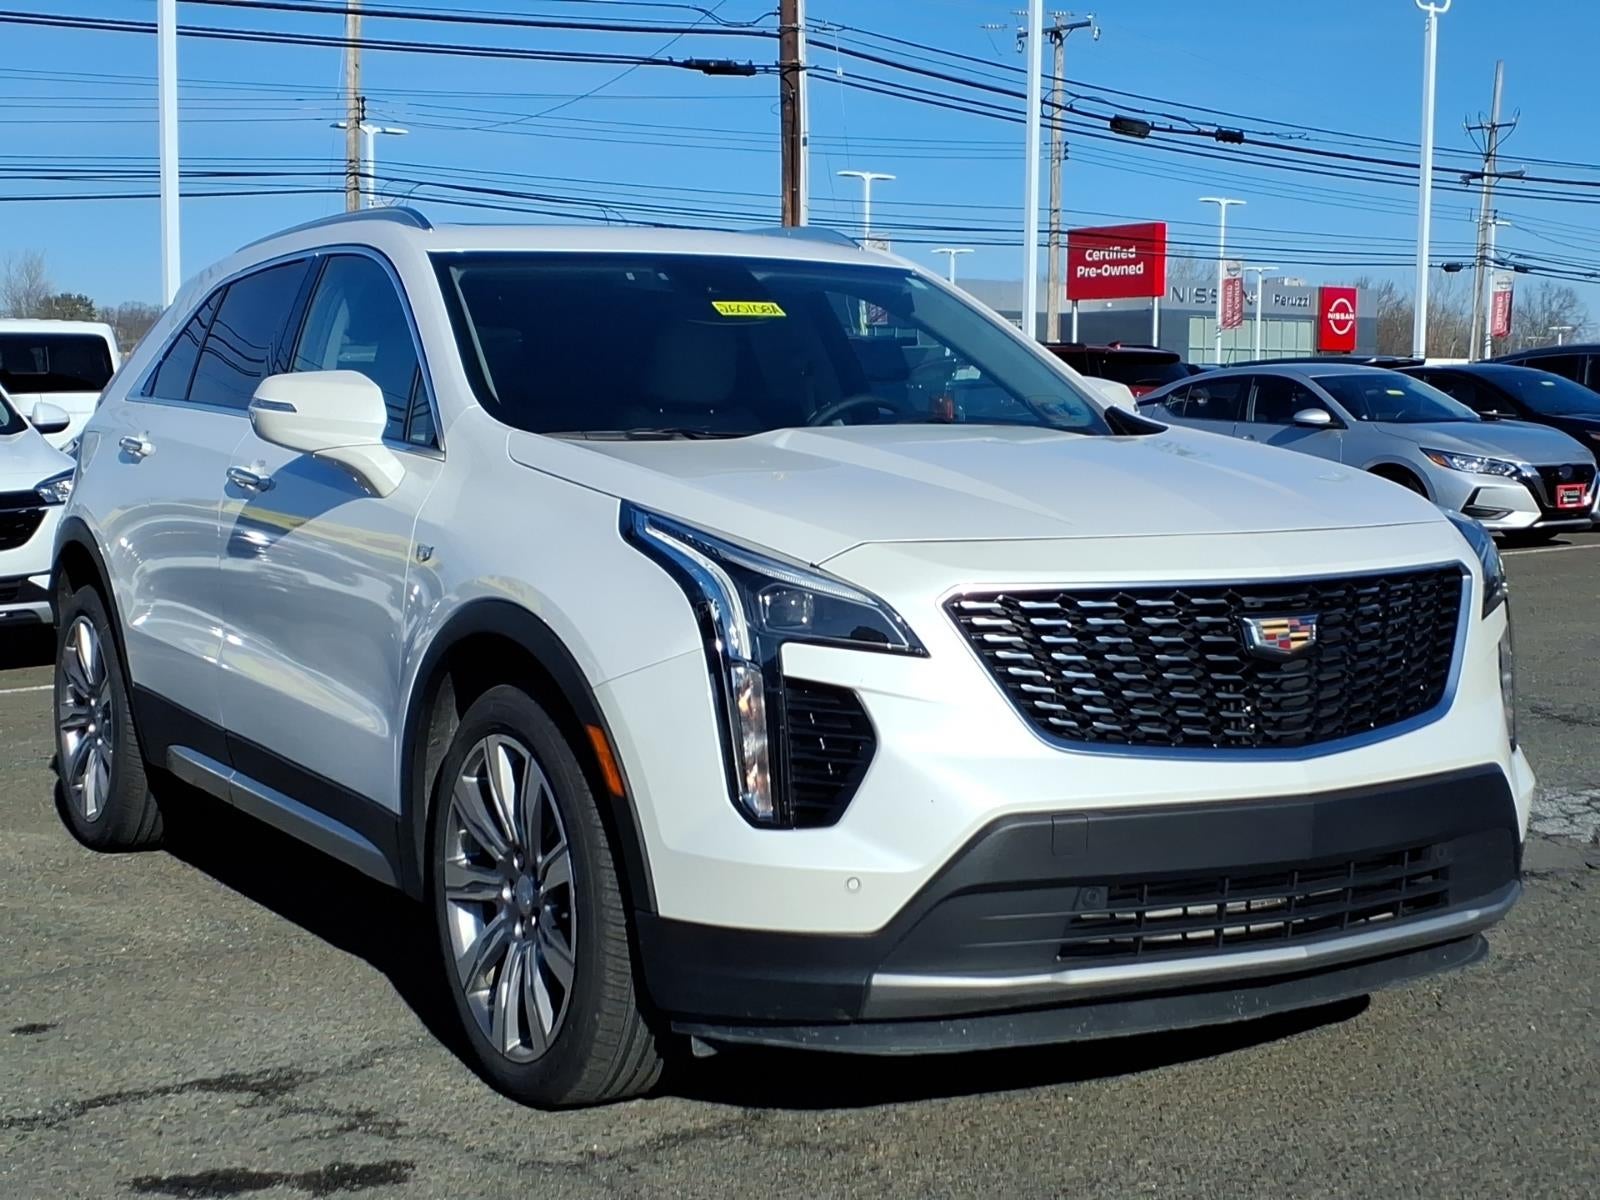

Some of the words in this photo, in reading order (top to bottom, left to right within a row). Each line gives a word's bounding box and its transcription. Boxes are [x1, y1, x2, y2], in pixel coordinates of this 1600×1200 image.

[1085, 245, 1136, 261] Certified
[1077, 261, 1144, 278] Pre-Owned
[1170, 286, 1253, 305] NISSN
[1273, 294, 1311, 307] Peruzzi
[1327, 312, 1355, 320] NISSAN
